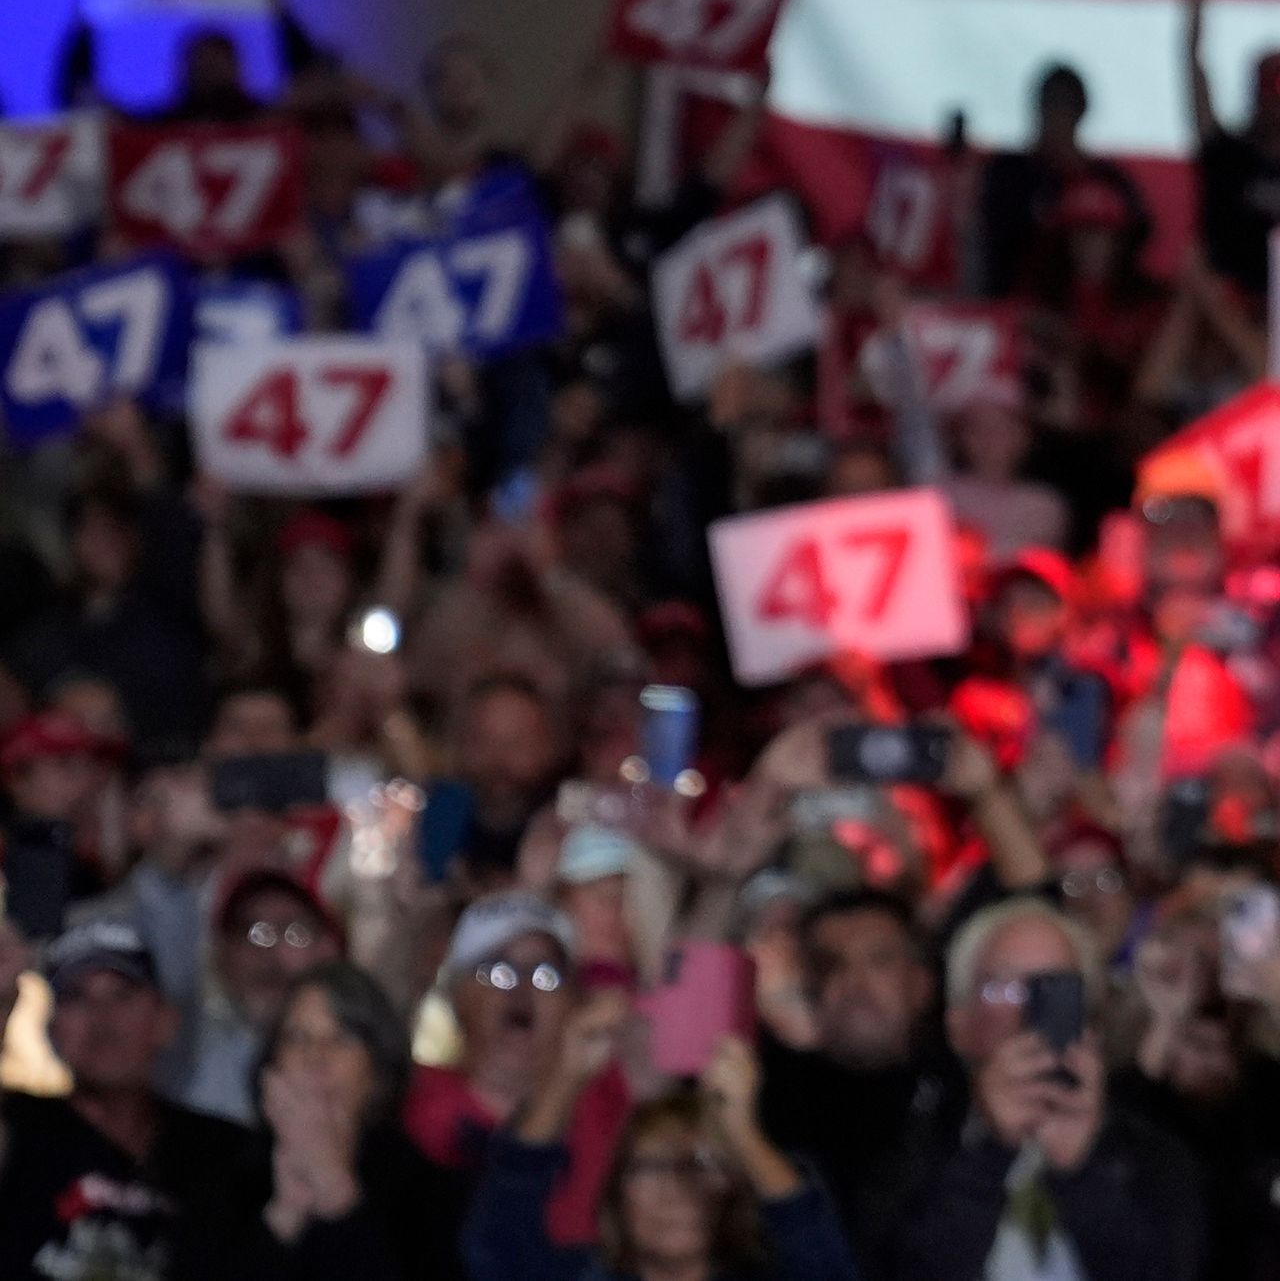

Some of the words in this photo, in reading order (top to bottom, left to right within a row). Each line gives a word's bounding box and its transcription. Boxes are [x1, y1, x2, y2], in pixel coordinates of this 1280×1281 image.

[118, 138, 283, 232] 47
[8, 265, 168, 403] 47
[375, 231, 531, 344] 47
[681, 236, 772, 345] 47
[225, 364, 394, 458] 47
[758, 529, 909, 625] 47
